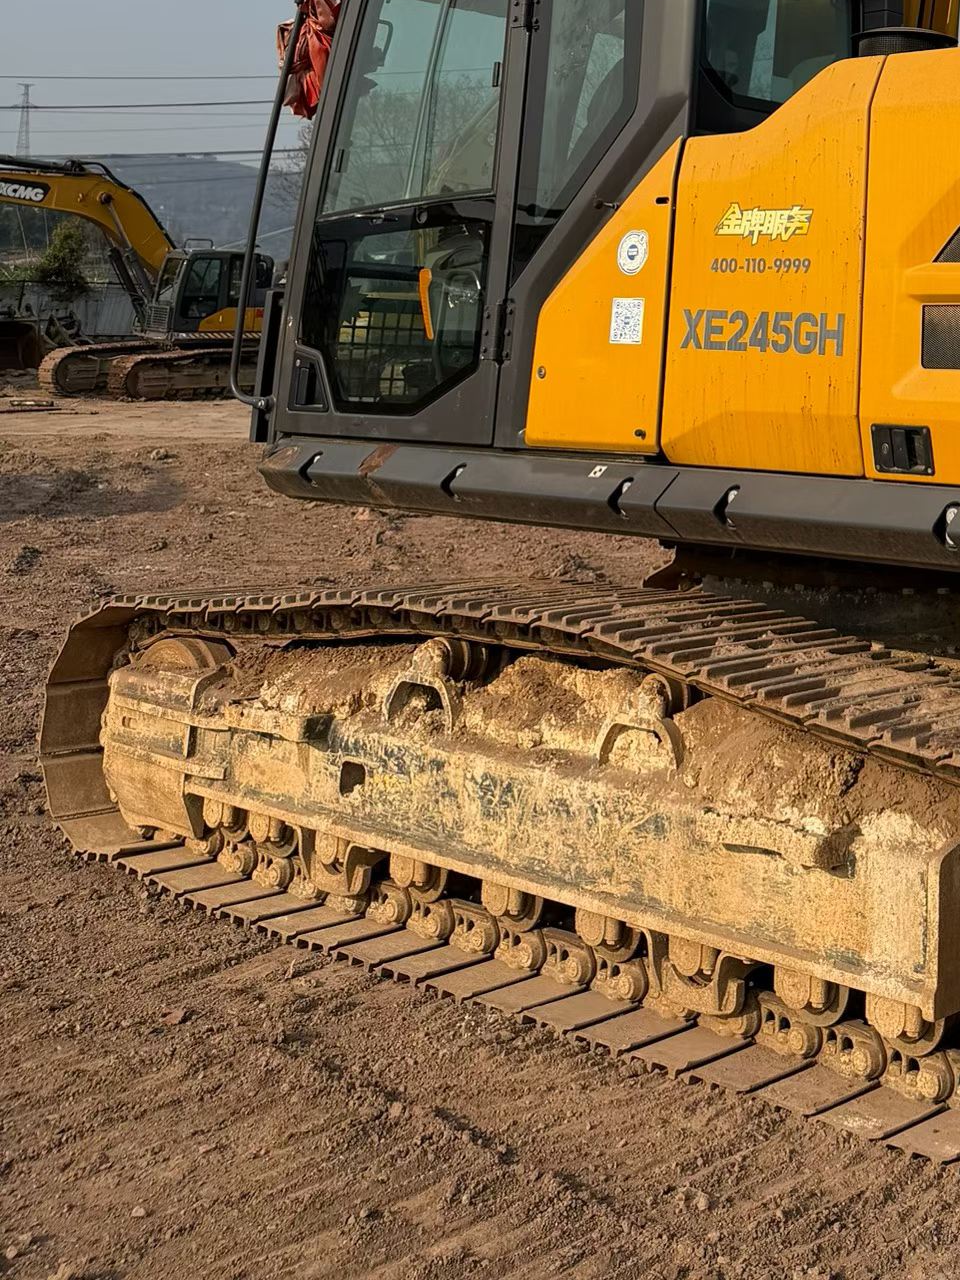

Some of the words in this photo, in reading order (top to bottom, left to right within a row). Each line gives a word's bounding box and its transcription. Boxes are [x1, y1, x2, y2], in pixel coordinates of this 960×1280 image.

[714, 202, 813, 246] 金牌服务
[710, 258, 811, 273] 400-110-9999
[680, 309, 846, 356] XE245GH
